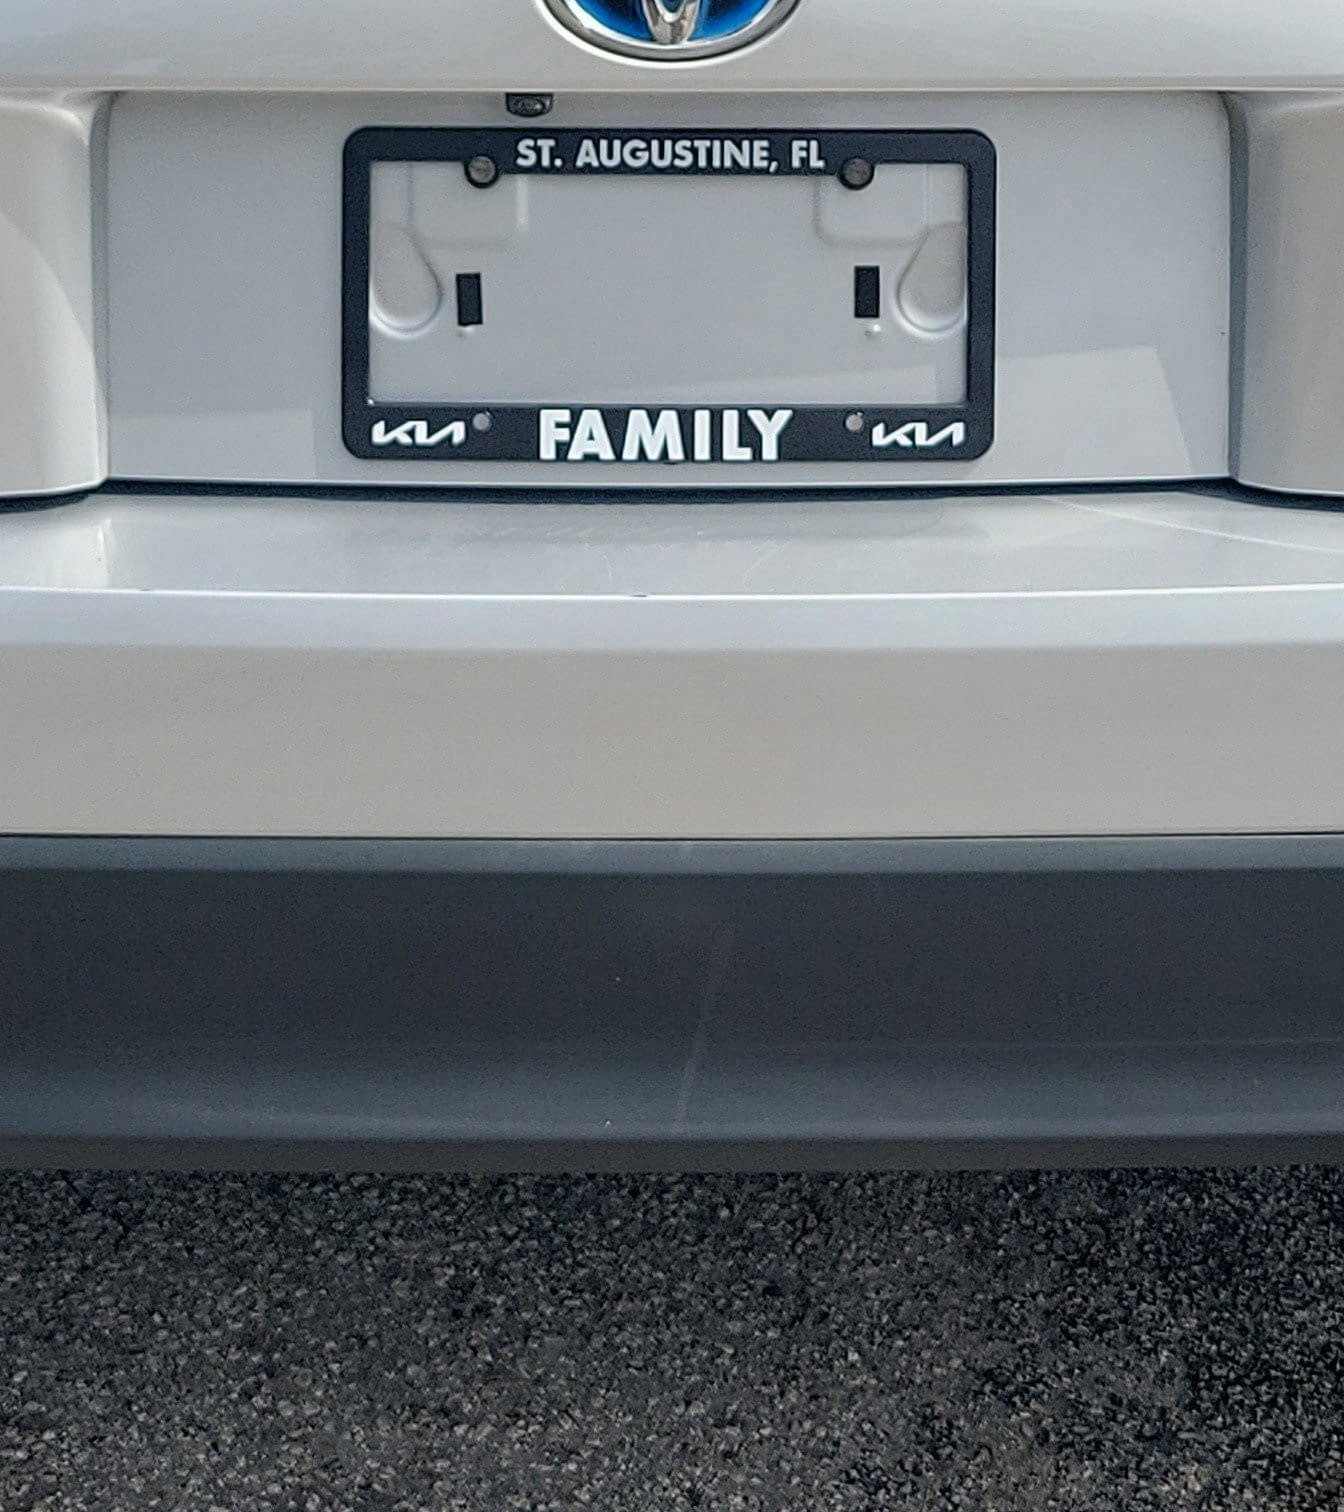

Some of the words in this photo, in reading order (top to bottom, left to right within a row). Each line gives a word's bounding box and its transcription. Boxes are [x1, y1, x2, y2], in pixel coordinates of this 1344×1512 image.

[515, 138, 562, 168] ST.
[575, 139, 779, 174] AUGUSTINE,
[790, 139, 825, 170] FL
[371, 419, 466, 446] KIA
[538, 408, 794, 462] FAMILY
[870, 420, 966, 448] KIA
